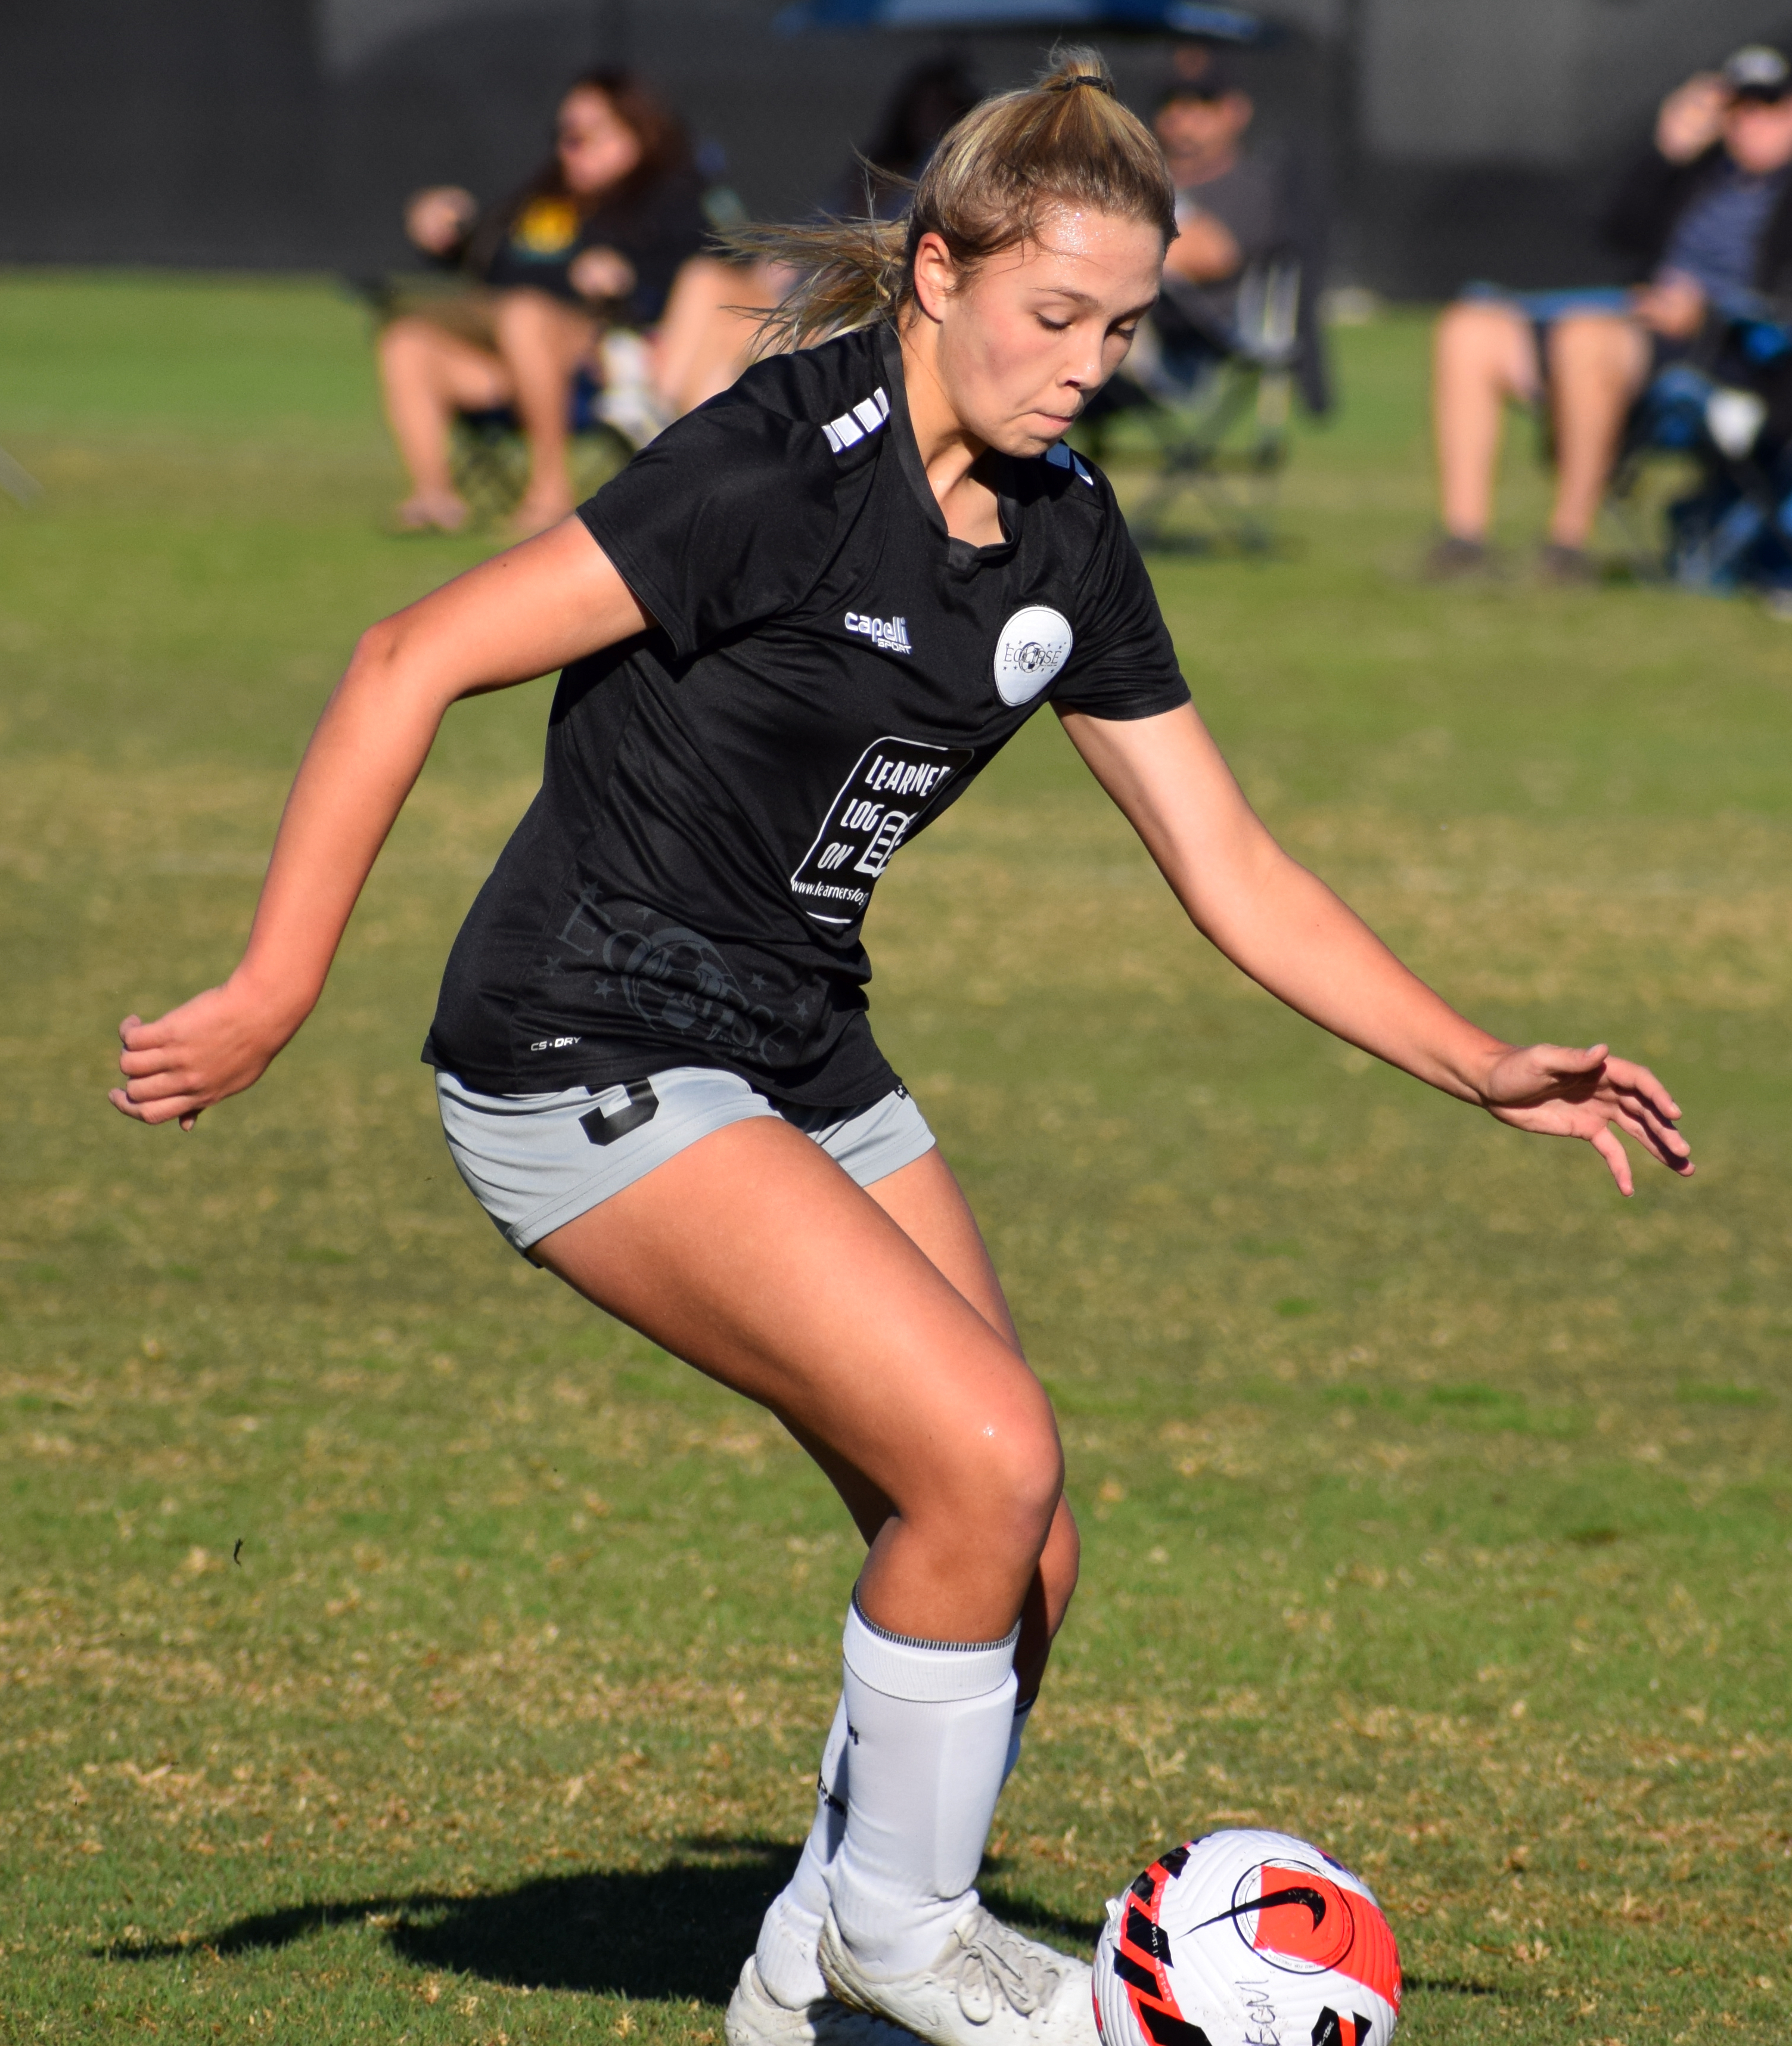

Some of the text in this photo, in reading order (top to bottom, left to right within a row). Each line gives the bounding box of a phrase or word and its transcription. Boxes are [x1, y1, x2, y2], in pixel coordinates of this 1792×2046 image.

[845, 612, 909, 645] capelli
[877, 638, 911, 654] SPORT
[1004, 647, 1062, 665] ECLIPSE
[840, 798, 885, 831] LOG
[817, 842, 855, 870] ON
